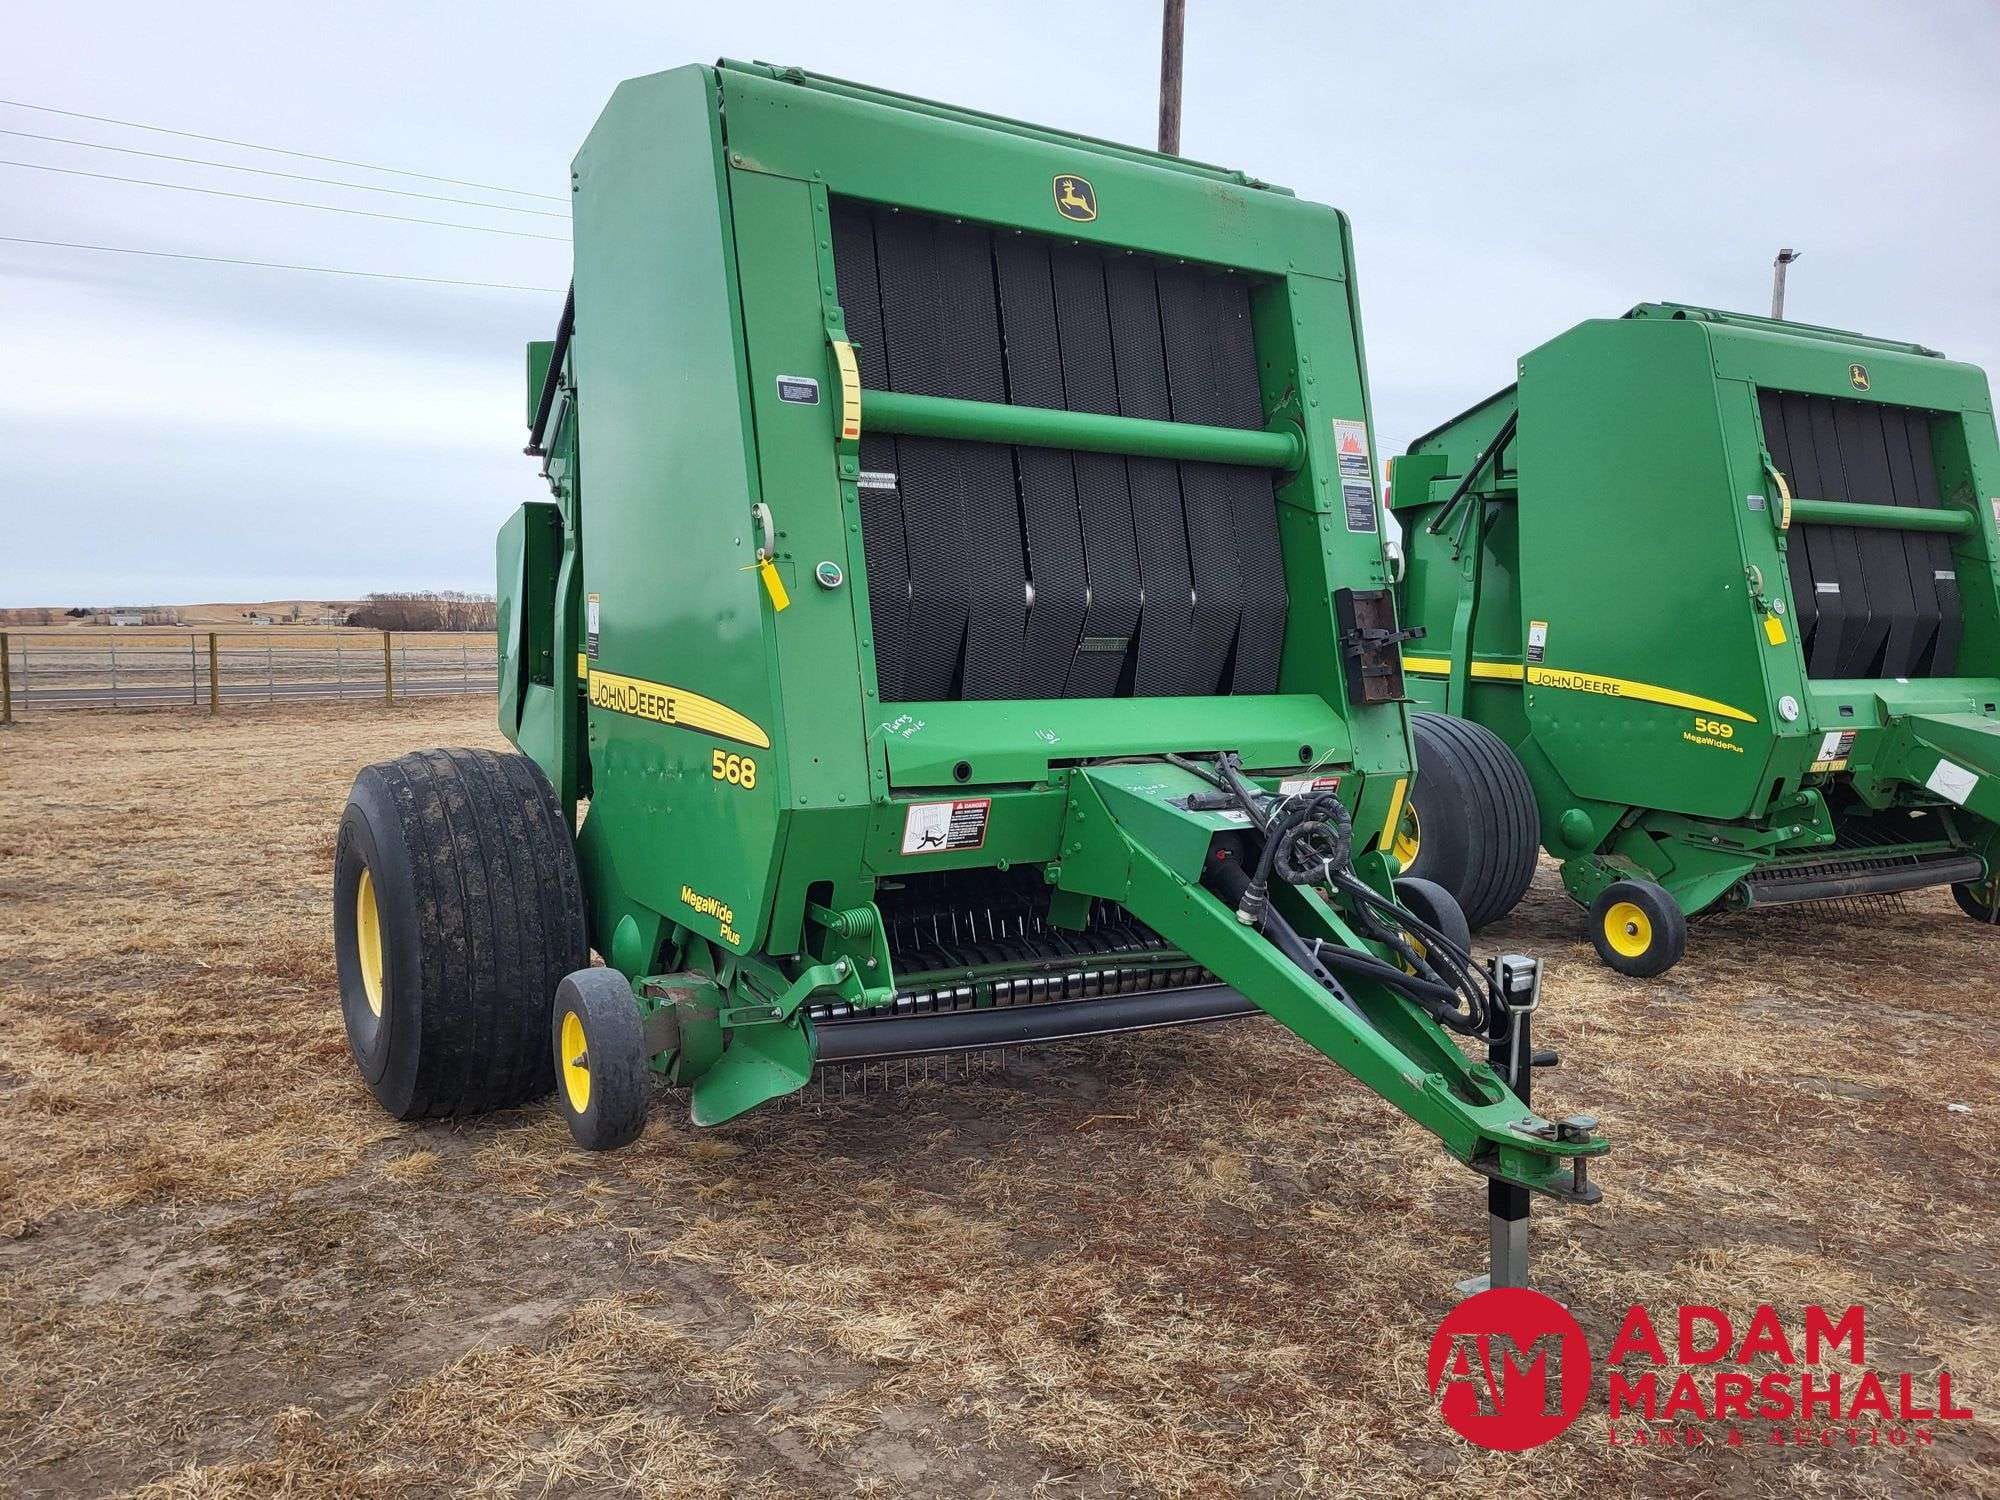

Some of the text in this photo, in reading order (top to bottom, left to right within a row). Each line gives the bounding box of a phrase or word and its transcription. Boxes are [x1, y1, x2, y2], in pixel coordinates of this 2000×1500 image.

[1534, 671, 1620, 694] JOHN DEERE
[594, 678, 676, 721] JOHN DEERE
[1695, 717, 1733, 738] 569
[712, 749, 757, 790] 568
[681, 885, 733, 924] MegaWide
[720, 923, 741, 946] Plus
